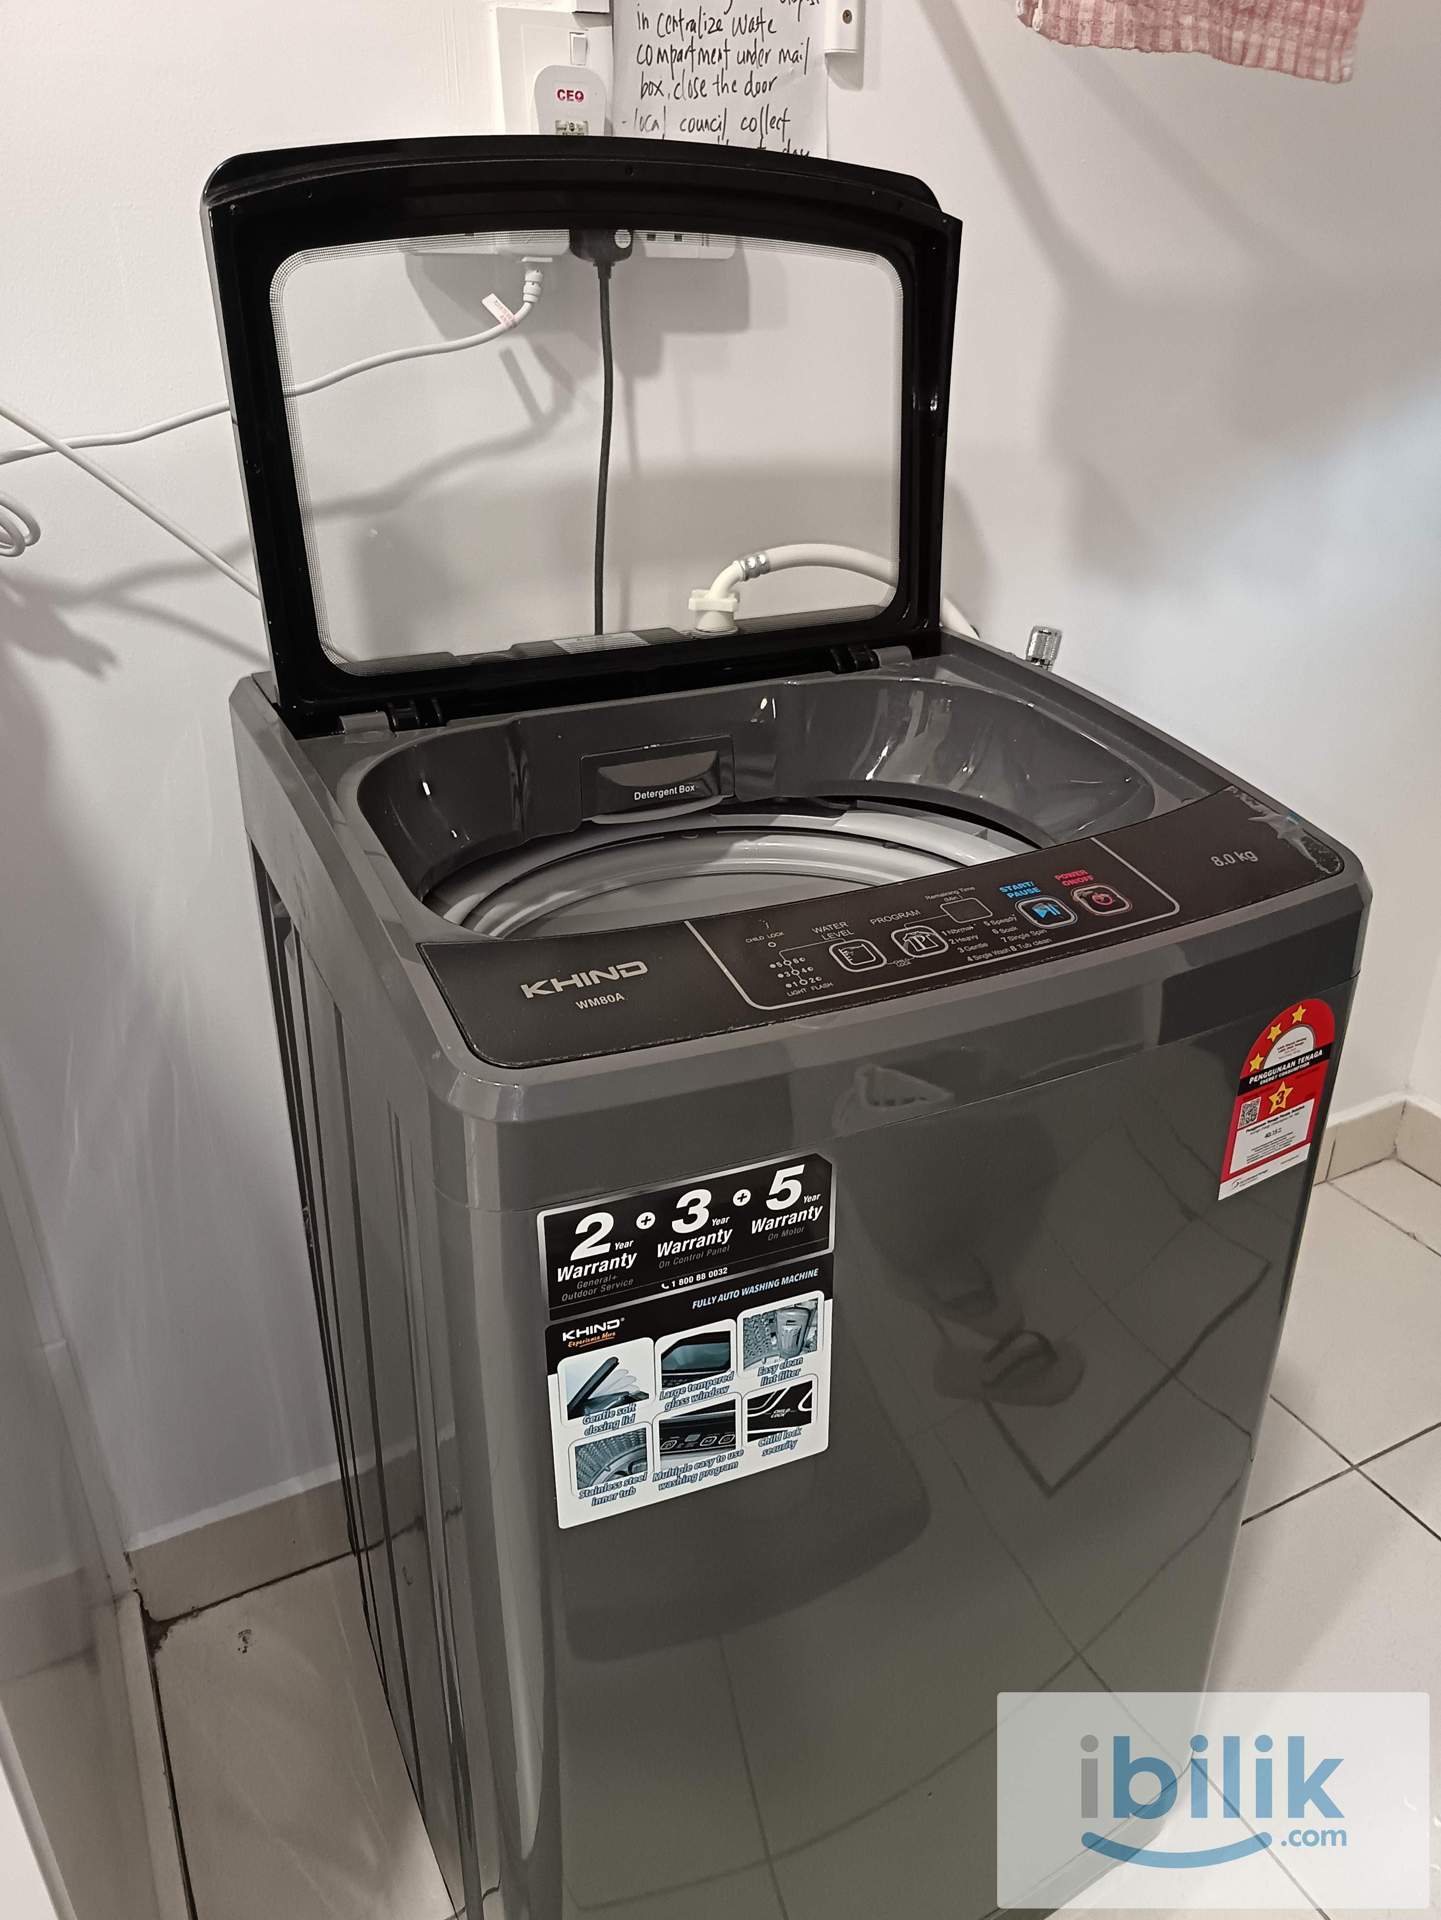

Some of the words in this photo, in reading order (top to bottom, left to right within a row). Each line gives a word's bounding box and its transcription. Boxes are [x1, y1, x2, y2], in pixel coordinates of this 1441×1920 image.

[636, 35, 731, 80] compartment
[736, 38, 772, 68] under
[778, 36, 810, 74] mail
[712, 67, 738, 97] the
[744, 69, 778, 98] door
[679, 107, 727, 140] council
[740, 104, 791, 142] collect
[633, 787, 678, 801] Detergent
[679, 784, 696, 794] Box
[1211, 853, 1236, 867] 8.0
[1234, 850, 1258, 863] kg
[1006, 887, 1041, 898] PAUSE
[811, 921, 849, 934] WATER
[870, 909, 921, 925] PROGRAM
[821, 929, 854, 940] LEVEL
[520, 960, 649, 999] KHIND
[576, 992, 625, 1010] WM80A
[786, 987, 807, 997] LIGHT
[1275, 1090, 1285, 1106] 3
[765, 1164, 805, 1211] 5
[803, 1192, 821, 1204] Year
[671, 1188, 713, 1234] 3
[711, 1215, 730, 1227] Year
[751, 1204, 823, 1235] Warranty
[570, 1211, 614, 1261] 2
[614, 1239, 634, 1251] Year
[656, 1227, 733, 1258] Warranty
[768, 1232, 779, 1241] On
[780, 1226, 805, 1239] Motor
[557, 1251, 638, 1283] Warranty
[658, 1260, 670, 1270] On
[673, 1251, 704, 1266] Control
[707, 1244, 731, 1257] Panel
[678, 1275, 694, 1286] 800
[696, 1272, 706, 1282] 88
[708, 1266, 729, 1278] 0032
[561, 1288, 597, 1302] Outdoor
[600, 1278, 634, 1293] Service
[692, 1297, 718, 1310] FULLY
[717, 1288, 740, 1302] AUTO
[741, 1279, 780, 1297] WASHING
[780, 1267, 819, 1286] MACHINE
[562, 1318, 621, 1341] KHIND
[757, 1364, 780, 1378] Easy
[779, 1356, 804, 1370] clean
[777, 1368, 801, 1383] filter
[659, 1386, 687, 1401] Large
[687, 1370, 735, 1393] tempered
[664, 1395, 690, 1412] glass
[691, 1385, 730, 1402] window
[582, 1409, 616, 1426] Gentle
[616, 1402, 637, 1417] soft
[583, 1419, 620, 1437] closing
[620, 1413, 636, 1427] lid
[761, 1440, 798, 1457] security
[651, 1463, 693, 1483] Multiple
[693, 1457, 716, 1471] easy
[715, 1453, 727, 1464] to
[726, 1448, 745, 1460] use
[658, 1472, 699, 1492] washing
[699, 1460, 739, 1481] program
[578, 1479, 622, 1500] Stainless
[623, 1471, 648, 1486] steel
[591, 1492, 617, 1507] inner
[618, 1486, 637, 1500] tub
